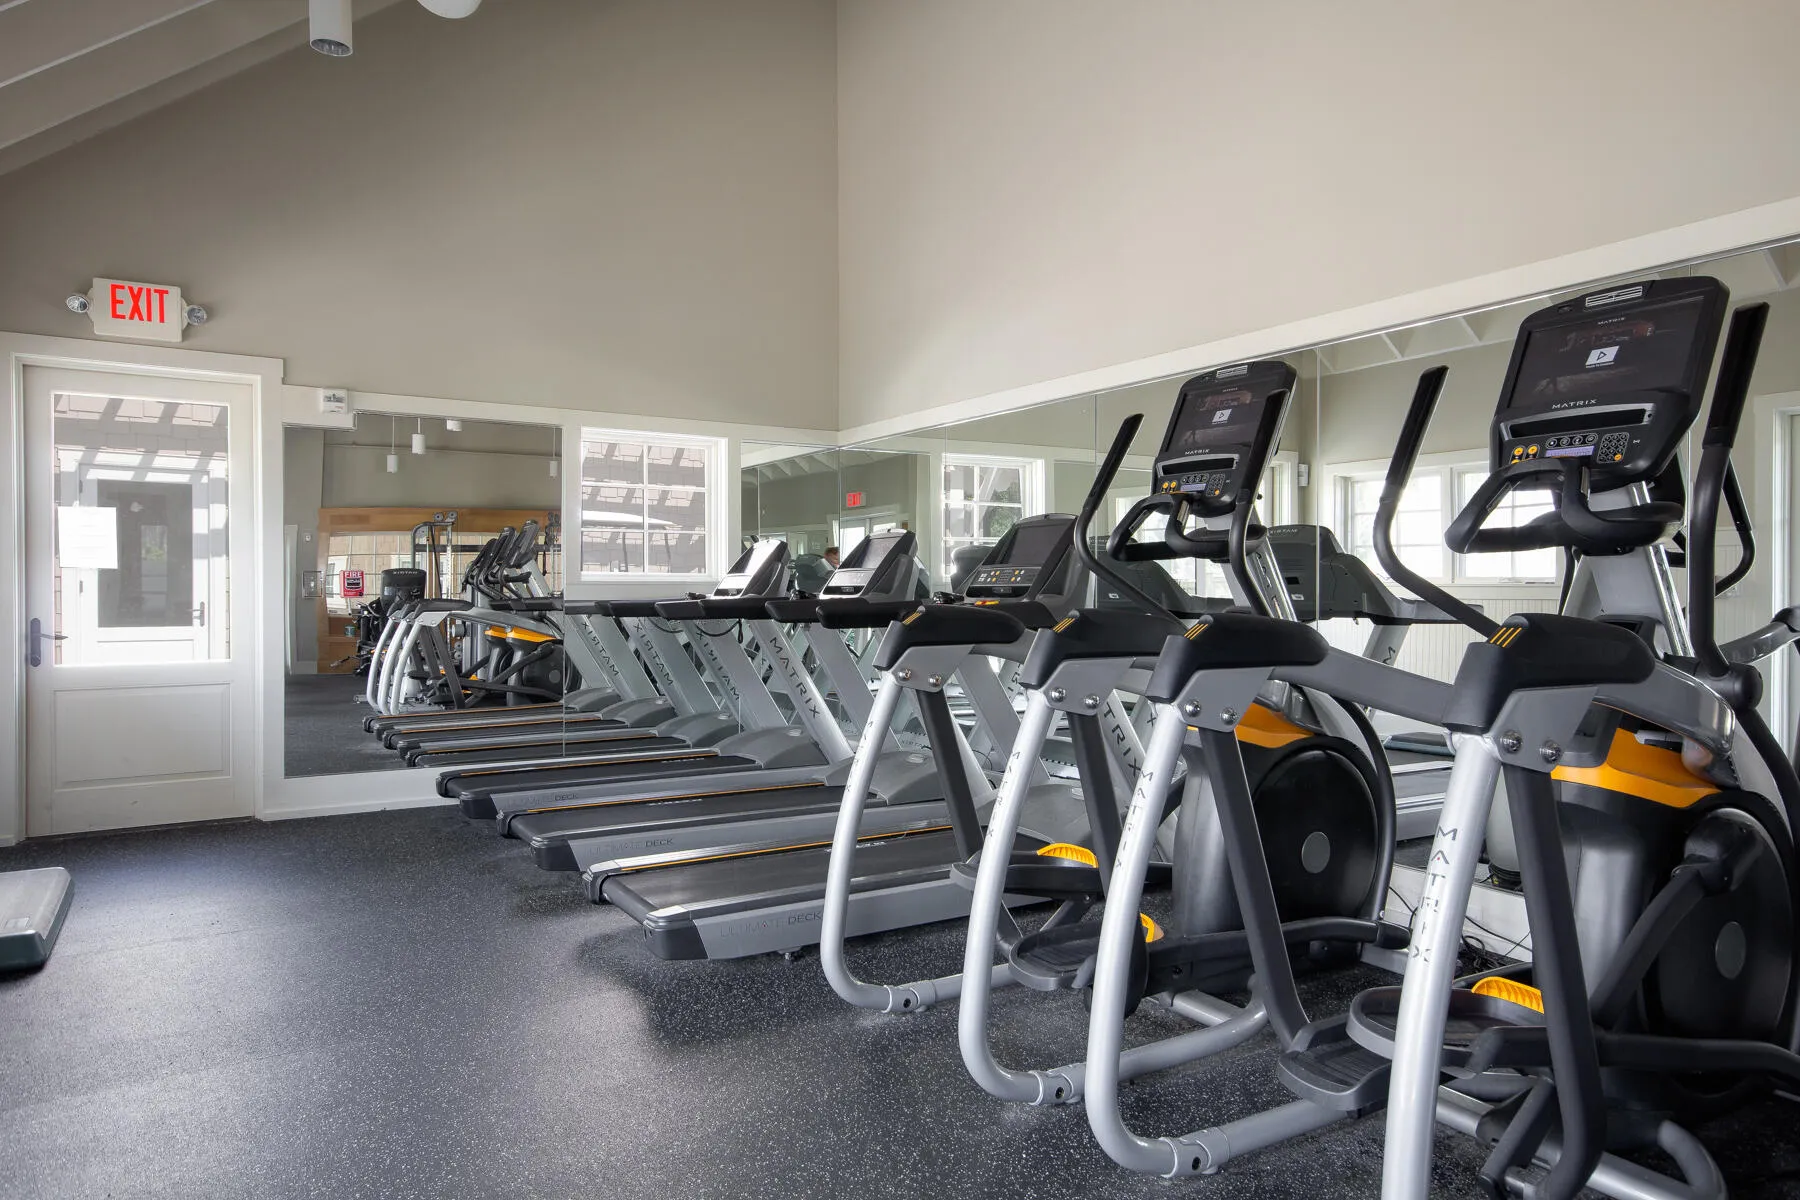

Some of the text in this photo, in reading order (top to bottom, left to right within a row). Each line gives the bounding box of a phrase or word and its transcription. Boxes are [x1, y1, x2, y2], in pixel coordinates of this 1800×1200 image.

[110, 283, 169, 323] EXIT
[1552, 399, 1597, 410] MATRIX
[769, 636, 820, 718] MATRIX
[1103, 702, 1142, 777] TRIX
[645, 838, 673, 848] DECK
[1412, 826, 1458, 963] MATRIX
[787, 911, 821, 926] DECK
